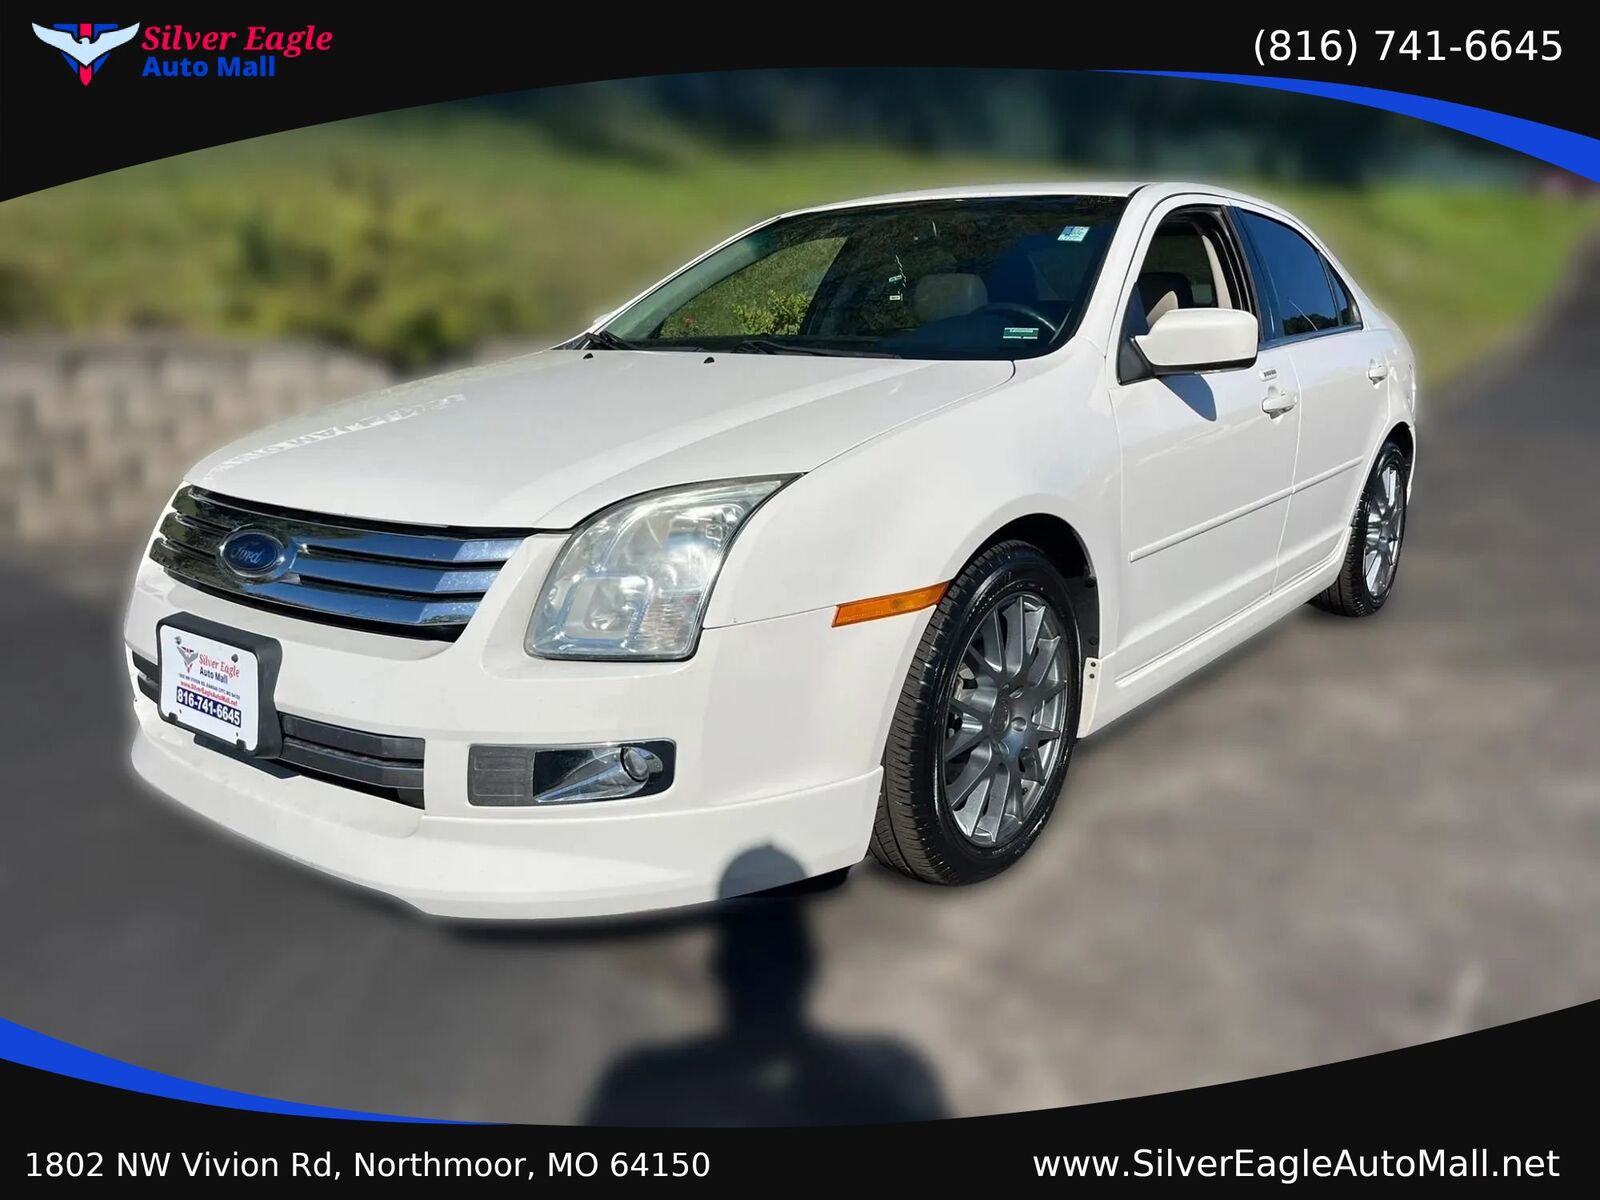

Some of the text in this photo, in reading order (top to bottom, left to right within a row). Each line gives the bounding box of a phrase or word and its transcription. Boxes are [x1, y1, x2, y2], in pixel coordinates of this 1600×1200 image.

[230, 545, 265, 564] Ford
[199, 654, 240, 678] Silver Eagle
[200, 667, 214, 679] Auto
[215, 672, 228, 684] Mall
[177, 688, 240, 726] 816-741-6645
